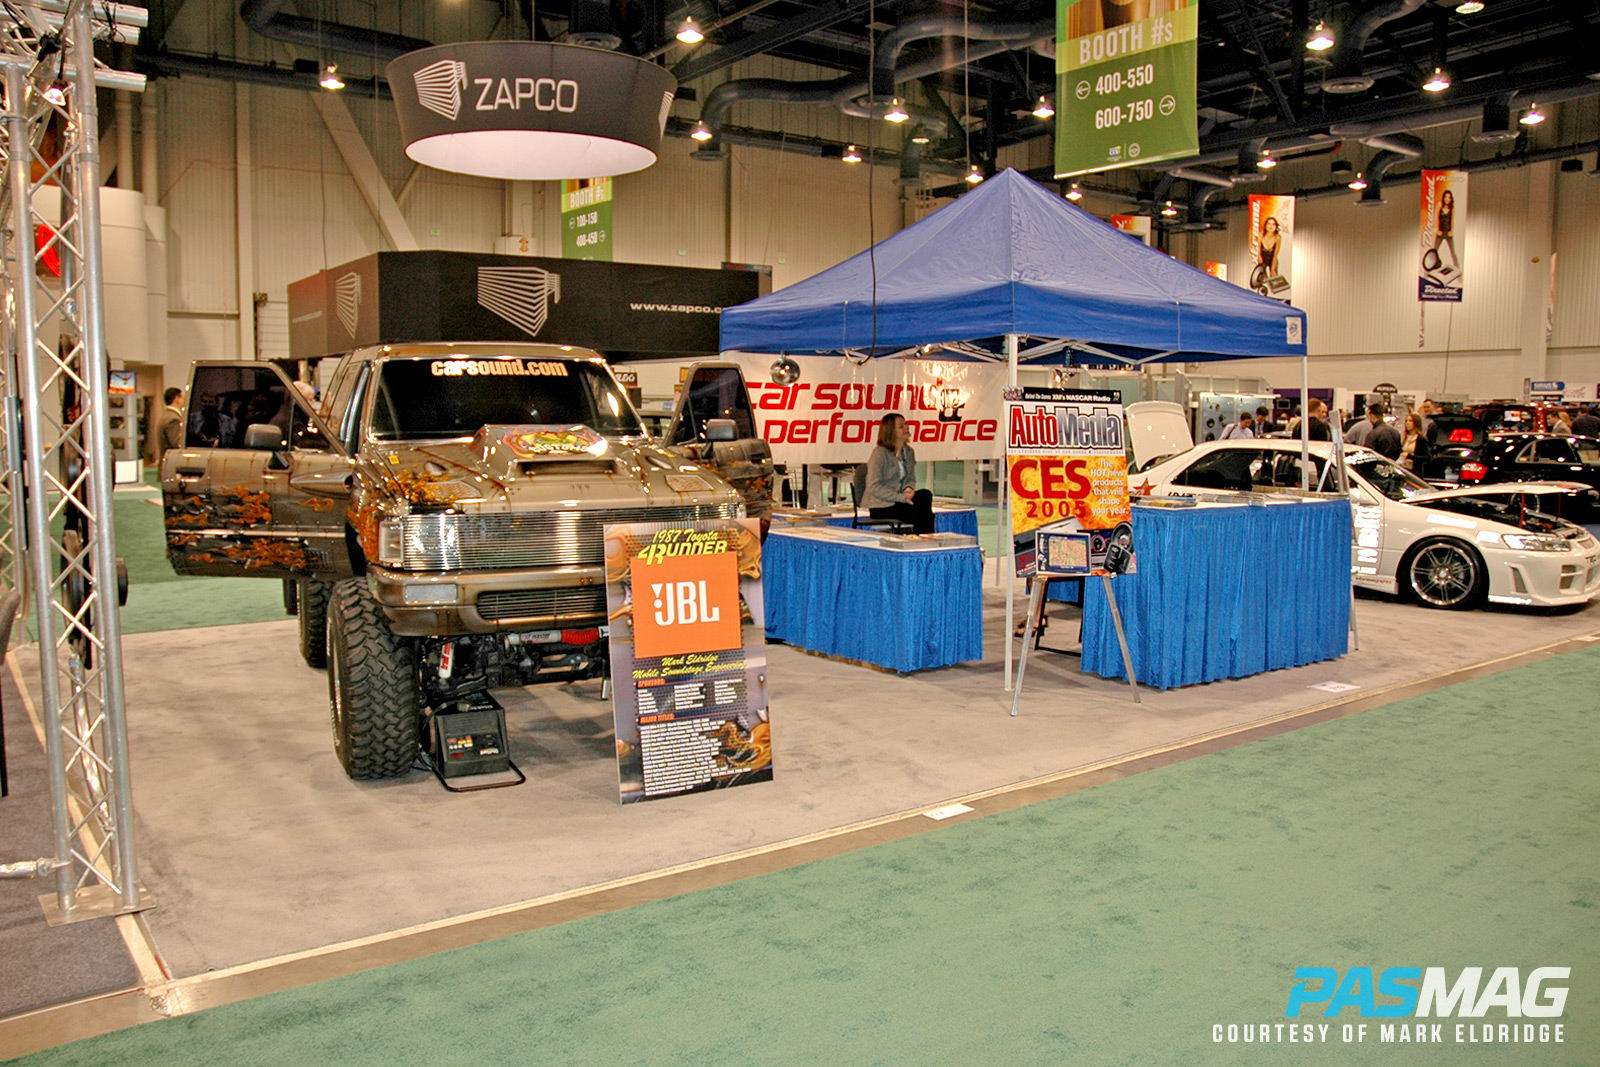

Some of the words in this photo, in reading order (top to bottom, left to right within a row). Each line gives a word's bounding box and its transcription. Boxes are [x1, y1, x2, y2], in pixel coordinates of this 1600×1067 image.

[1079, 22, 1144, 64] BOOTH
[1095, 63, 1154, 95] 400-550
[473, 77, 579, 113] ZAPCO
[1095, 98, 1154, 129] 600-750
[569, 187, 594, 209] BOOTH
[576, 211, 598, 228] 100-150
[576, 231, 598, 248] 400-450
[431, 358, 569, 377] carsound.com
[1066, 394, 1092, 402] NASCAR
[762, 412, 998, 444] perforance
[1009, 405, 1123, 448] AutoMedia
[1100, 459, 1114, 468] The
[1010, 459, 1092, 500] CES
[1091, 469, 1107, 477] HOT
[1092, 478, 1125, 487] products
[1093, 487, 1110, 496] that
[1111, 487, 1124, 496] will
[1098, 498, 1121, 506] shape
[1092, 507, 1109, 517] your
[1110, 507, 1130, 517] year.
[651, 529, 682, 544] 1987
[684, 528, 719, 544] Toyota
[651, 580, 720, 627] JBL
[661, 656, 685, 667] Mark
[686, 654, 719, 665] Eldridge
[632, 668, 659, 679] Mobile
